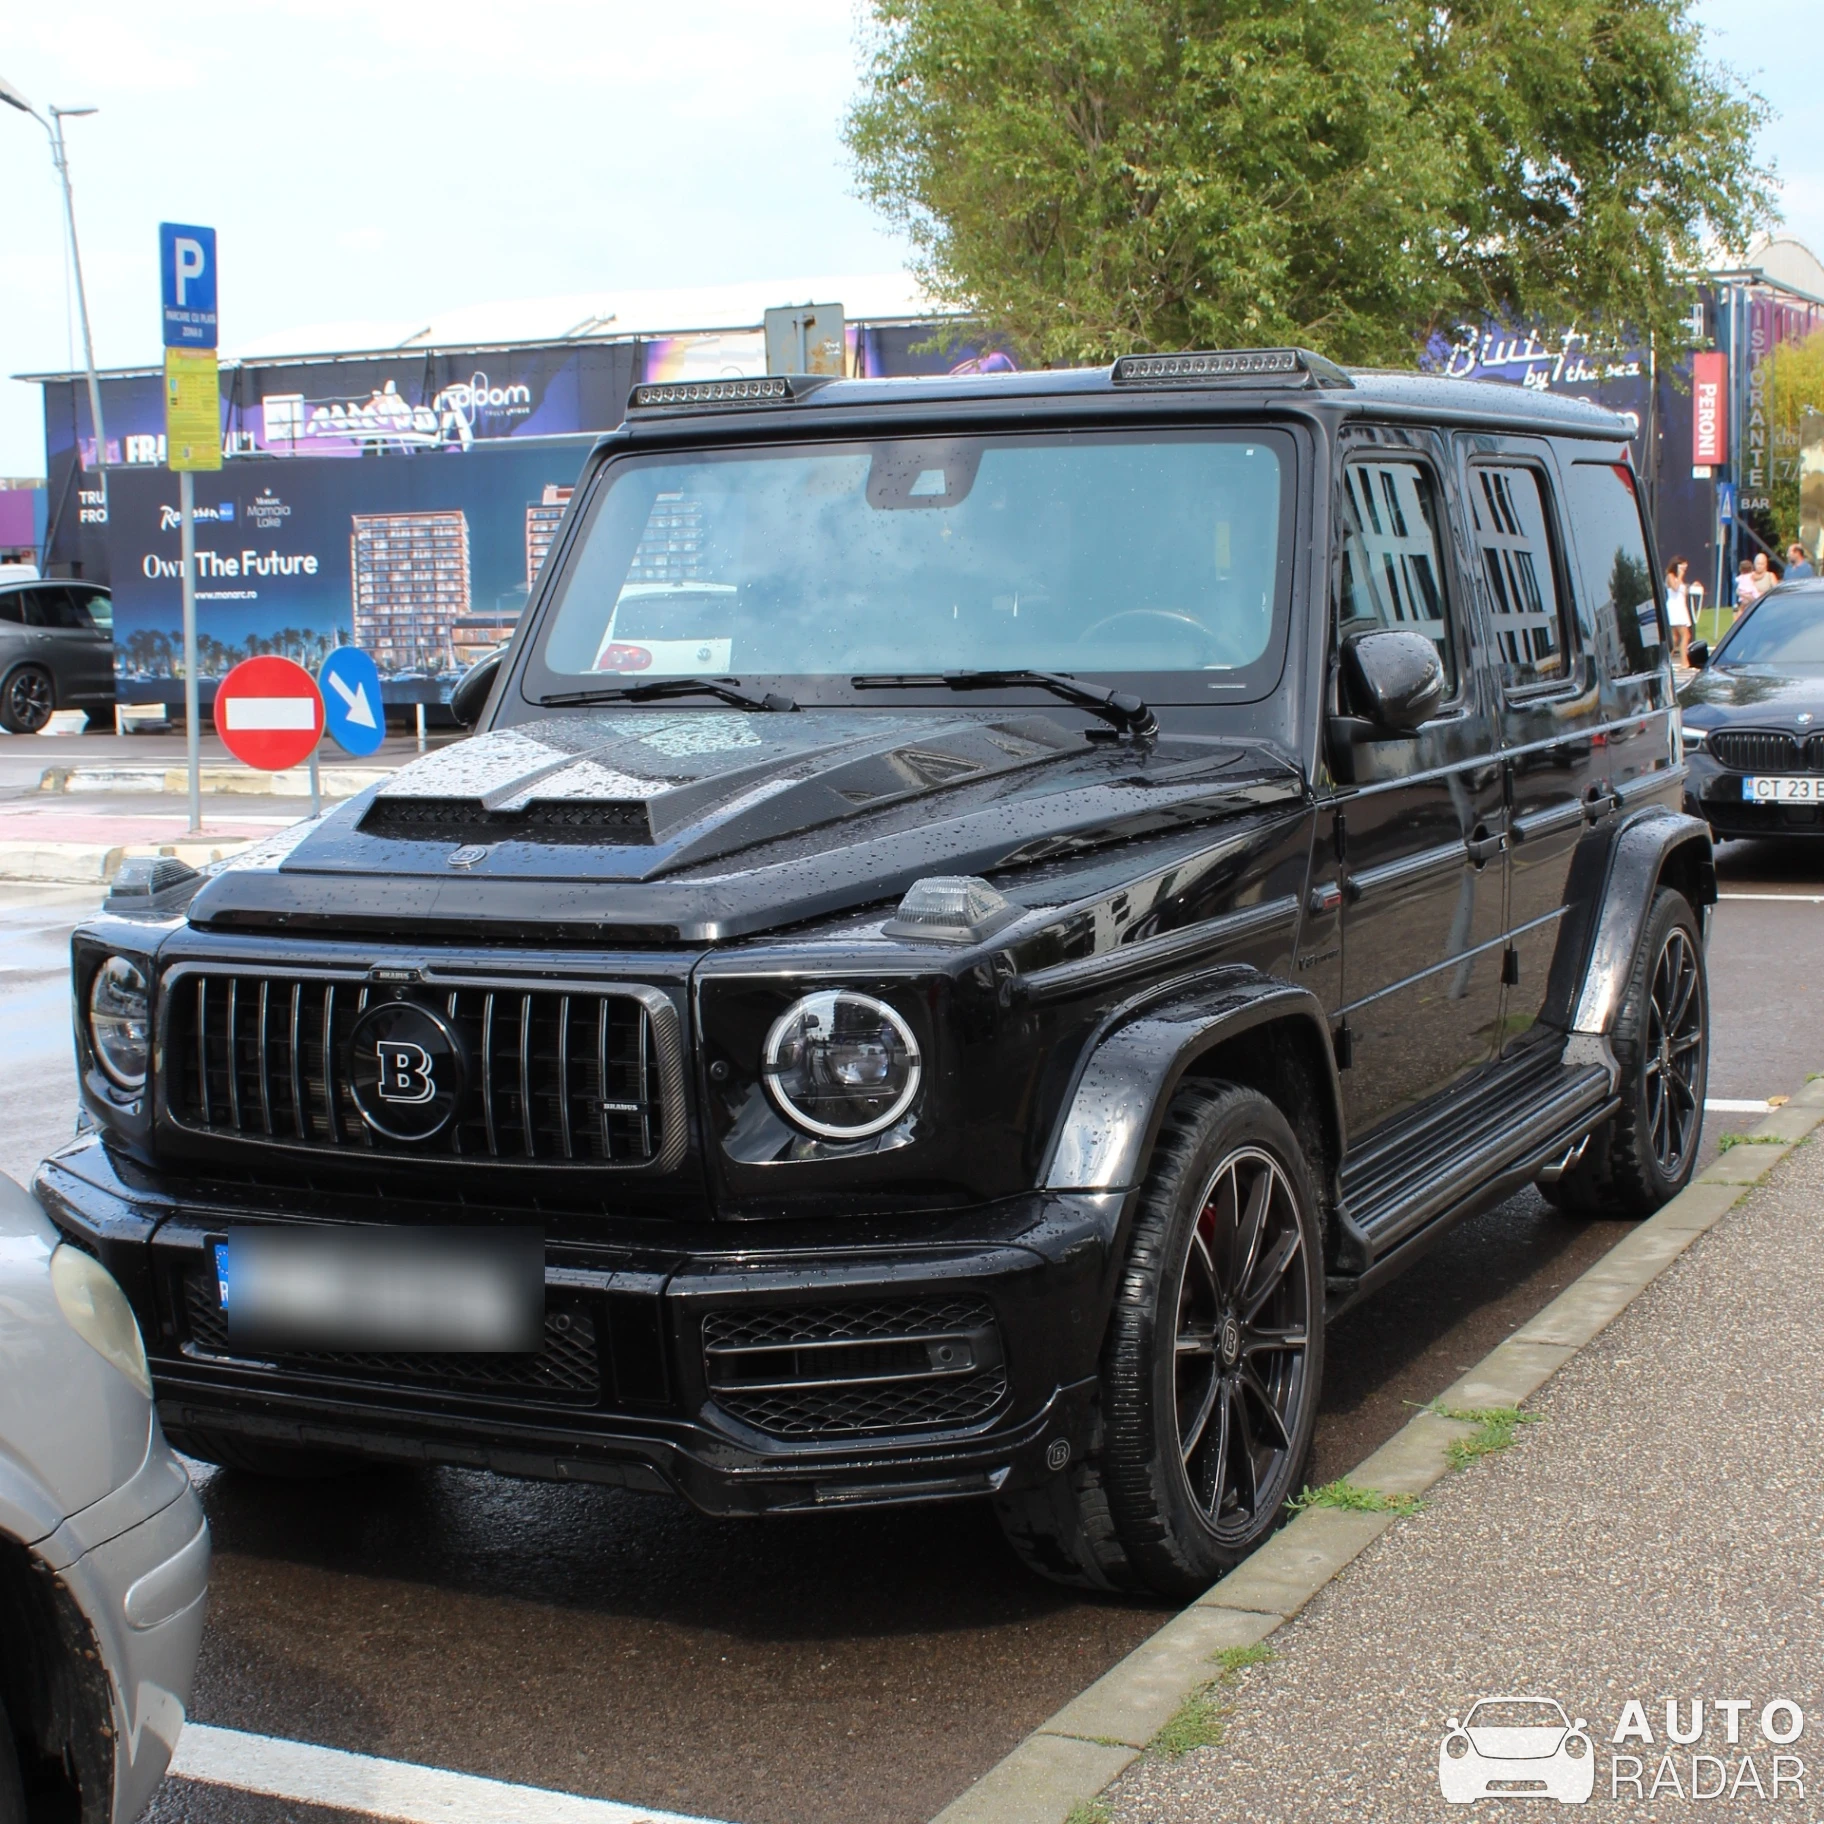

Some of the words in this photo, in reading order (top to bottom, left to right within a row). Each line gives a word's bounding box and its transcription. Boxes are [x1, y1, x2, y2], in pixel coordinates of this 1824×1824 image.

[175, 237, 205, 306] P
[1523, 364, 1550, 391] by
[1605, 362, 1640, 378] sea
[1698, 382, 1718, 457] PERONI
[1741, 498, 1770, 510] BAR
[160, 505, 219, 531] Rasson
[256, 516, 282, 528] Lake
[194, 551, 239, 577] The
[242, 550, 318, 576] Future
[1757, 780, 1781, 797] CT
[1788, 780, 1810, 798] 23
[377, 1041, 436, 1104] B
